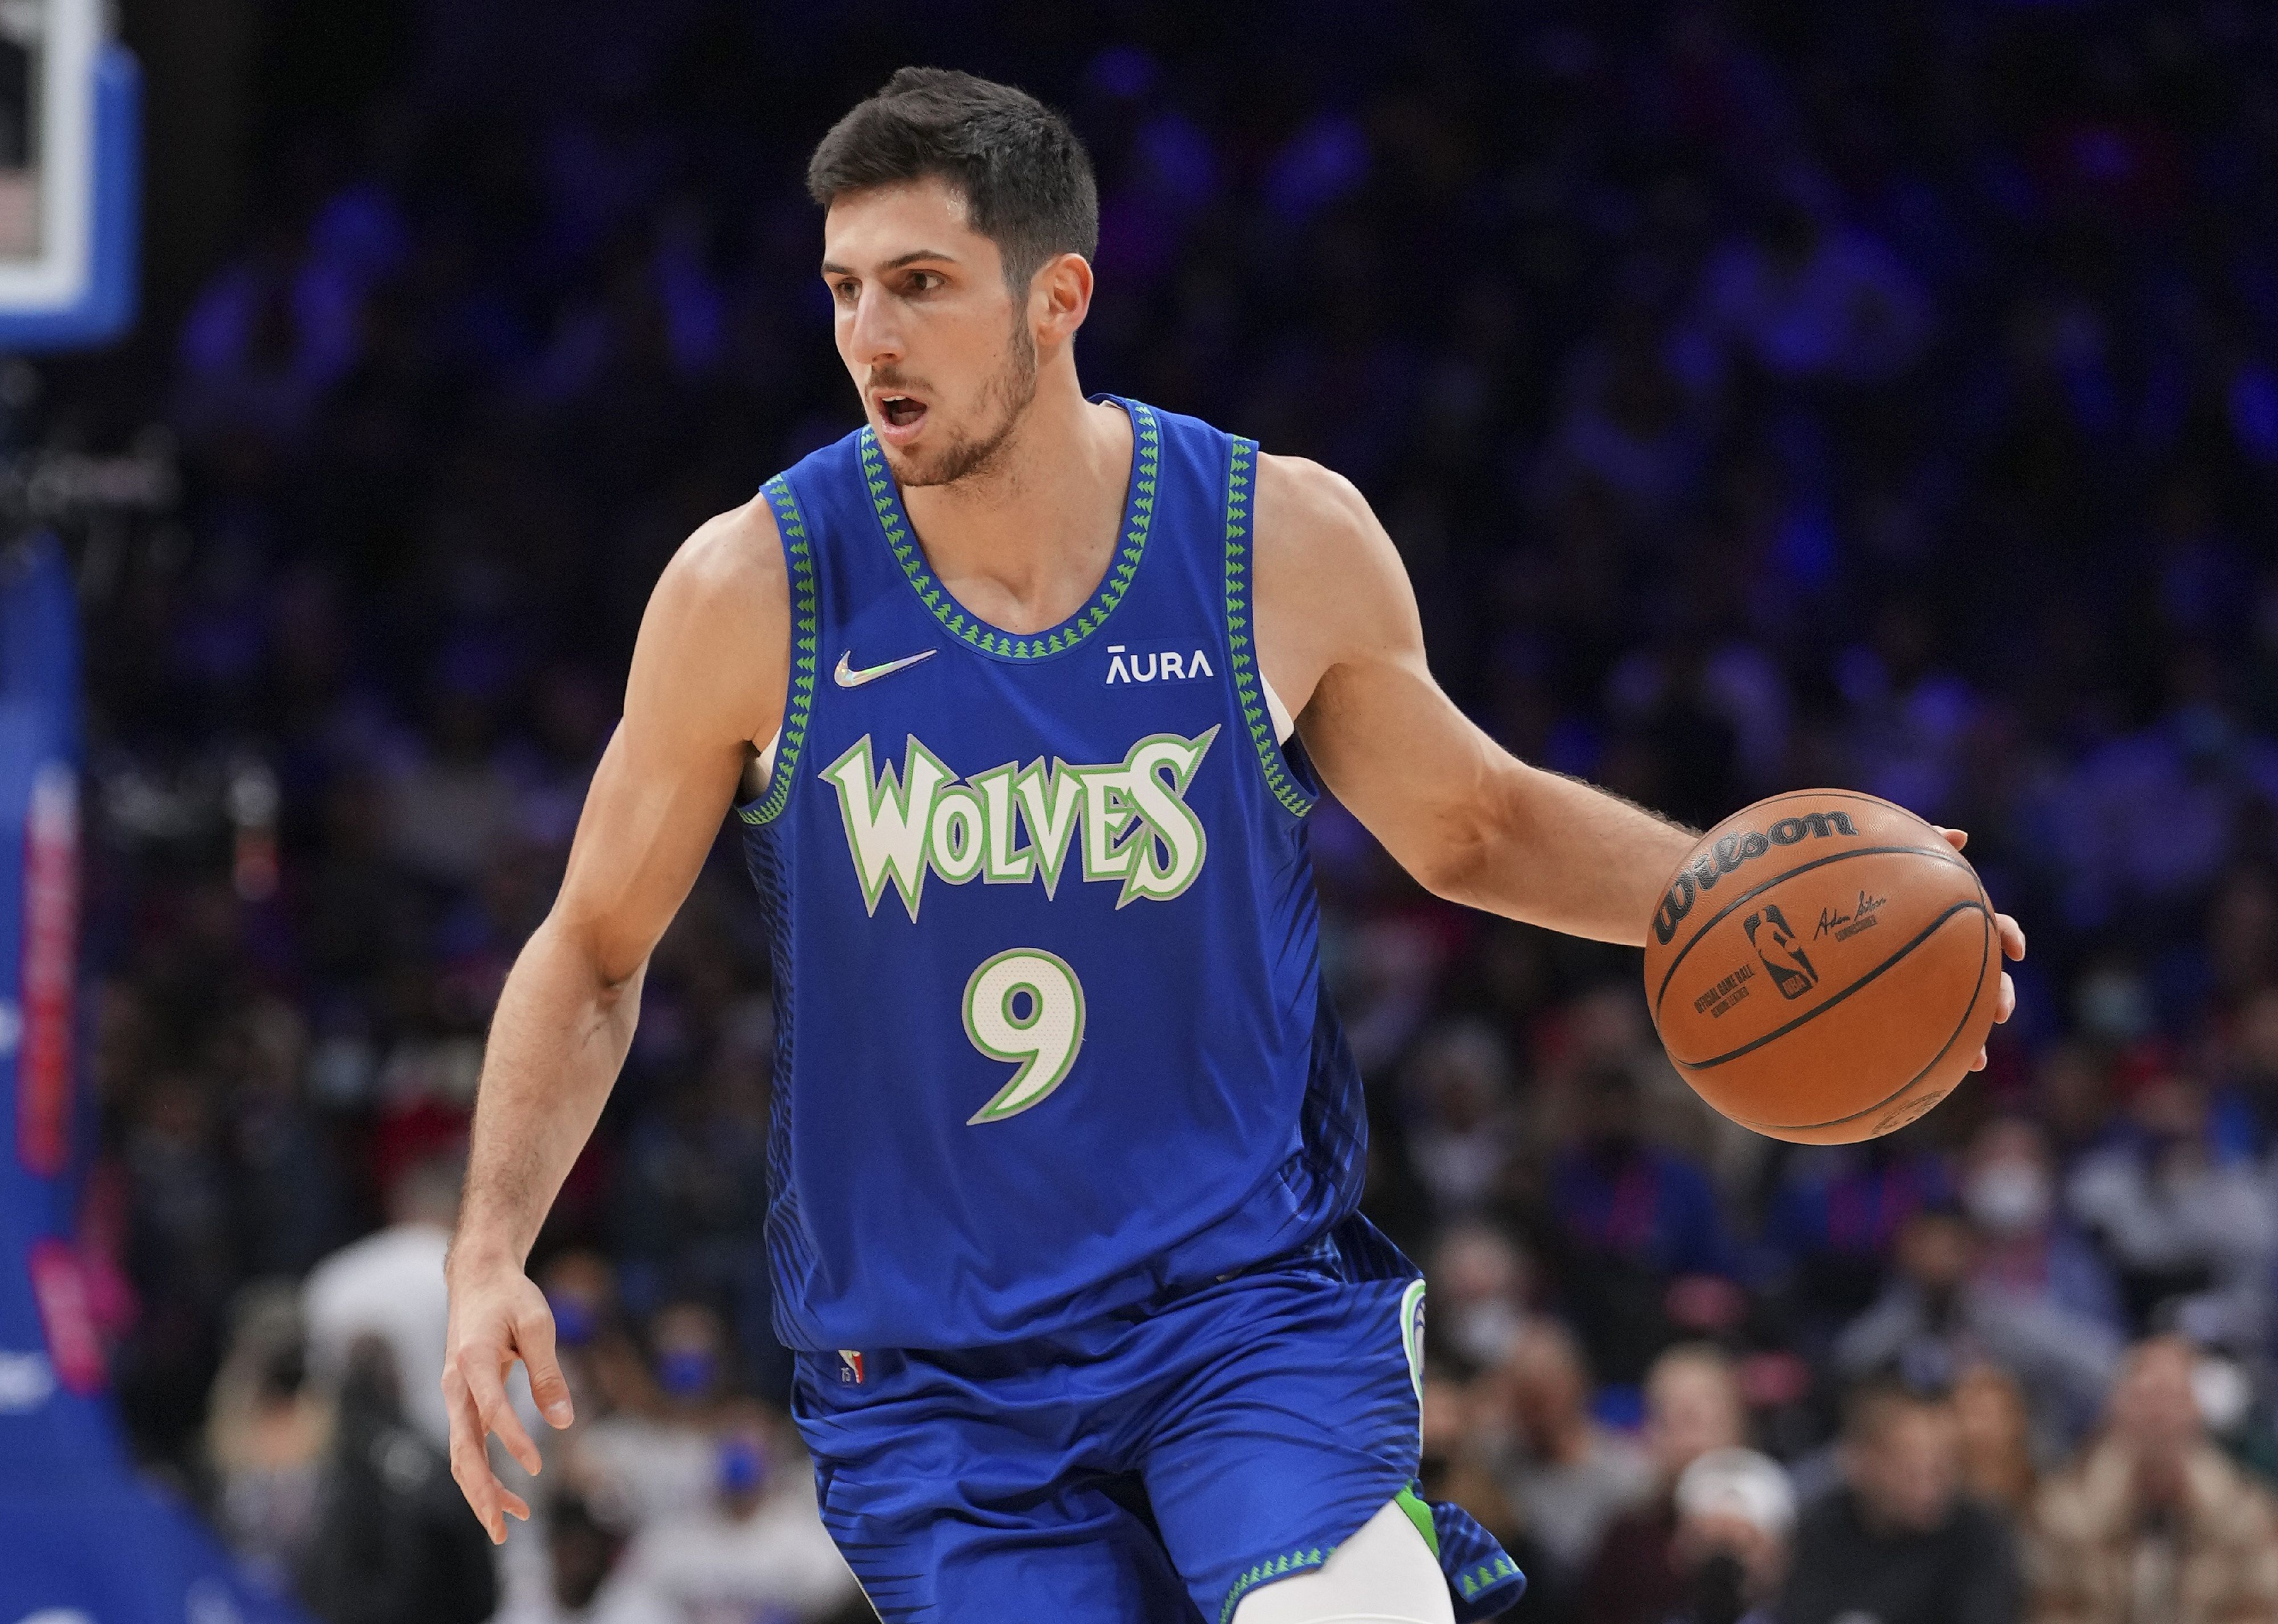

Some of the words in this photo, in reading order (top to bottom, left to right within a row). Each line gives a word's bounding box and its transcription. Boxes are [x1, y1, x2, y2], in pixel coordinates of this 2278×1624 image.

[818, 723, 1221, 924] WOLVES
[962, 947, 1085, 1125] 9
[1783, 974, 1806, 995] NBA
